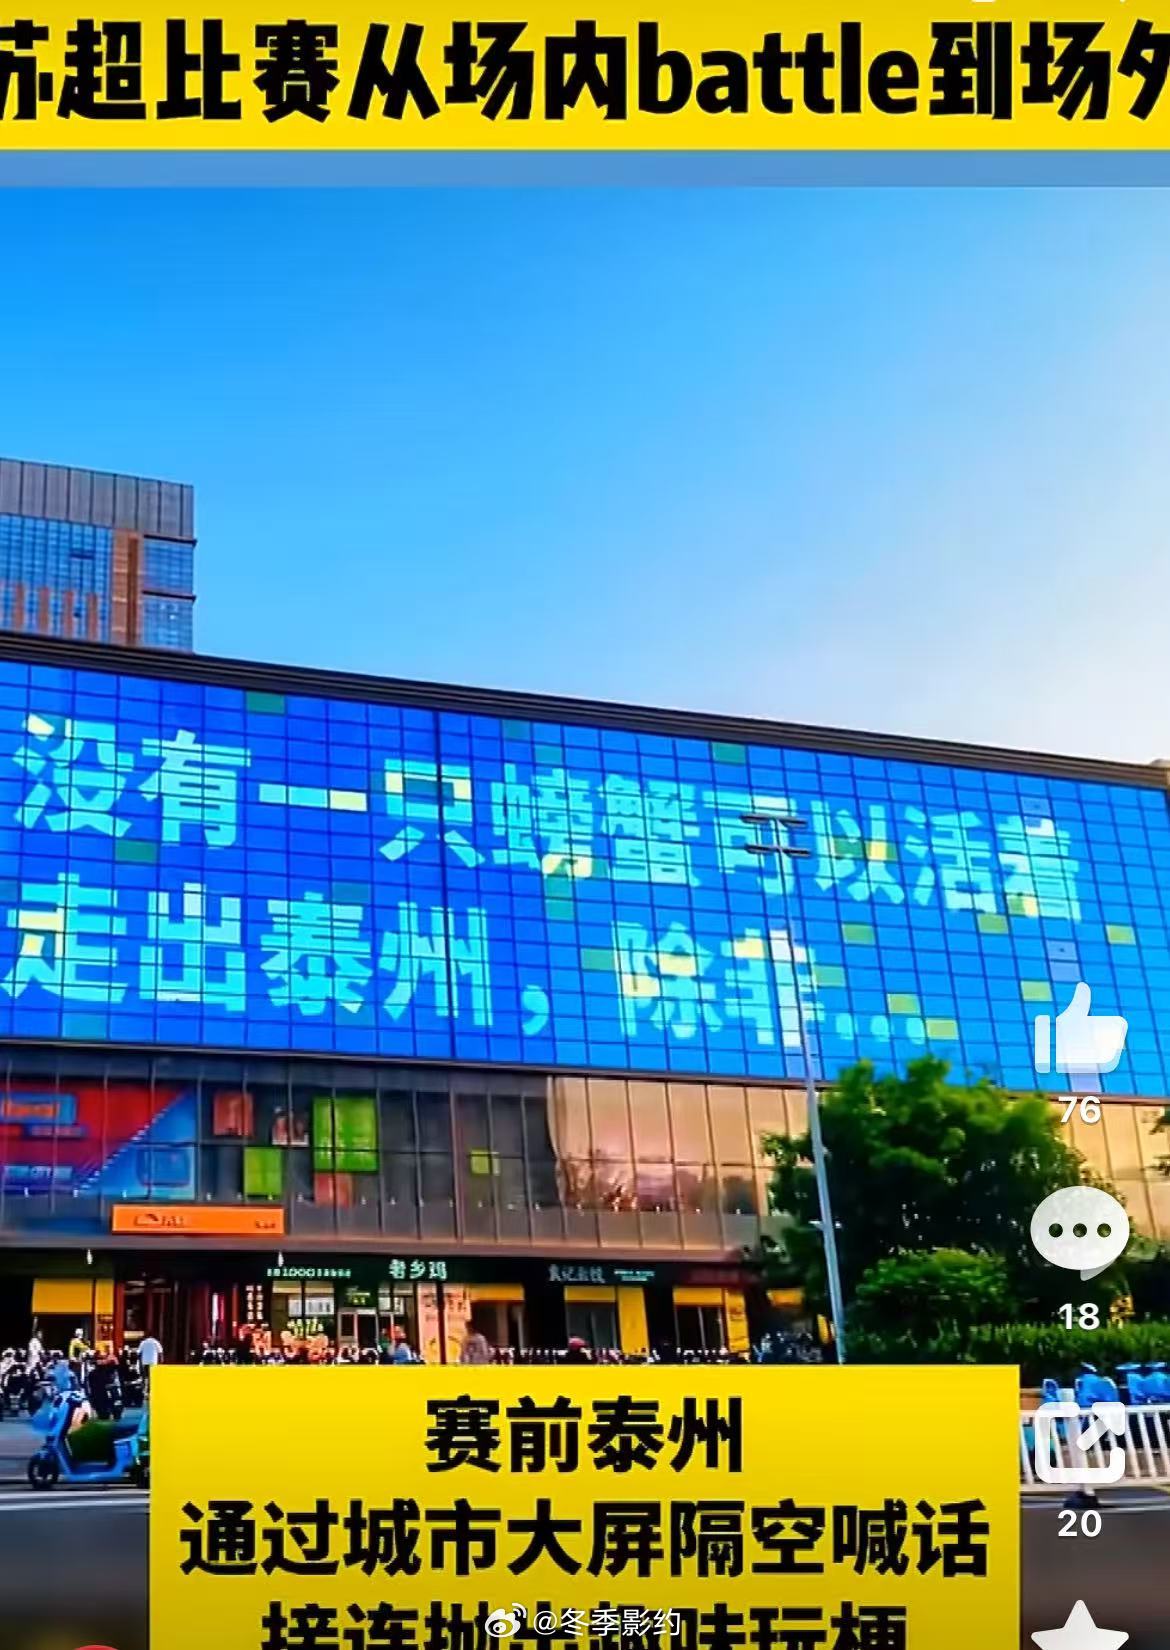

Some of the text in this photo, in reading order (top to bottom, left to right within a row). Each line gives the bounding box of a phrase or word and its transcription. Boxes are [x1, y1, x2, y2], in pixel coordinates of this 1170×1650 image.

[13, 713, 1081, 922] 没有一只螃蟹可以活着
